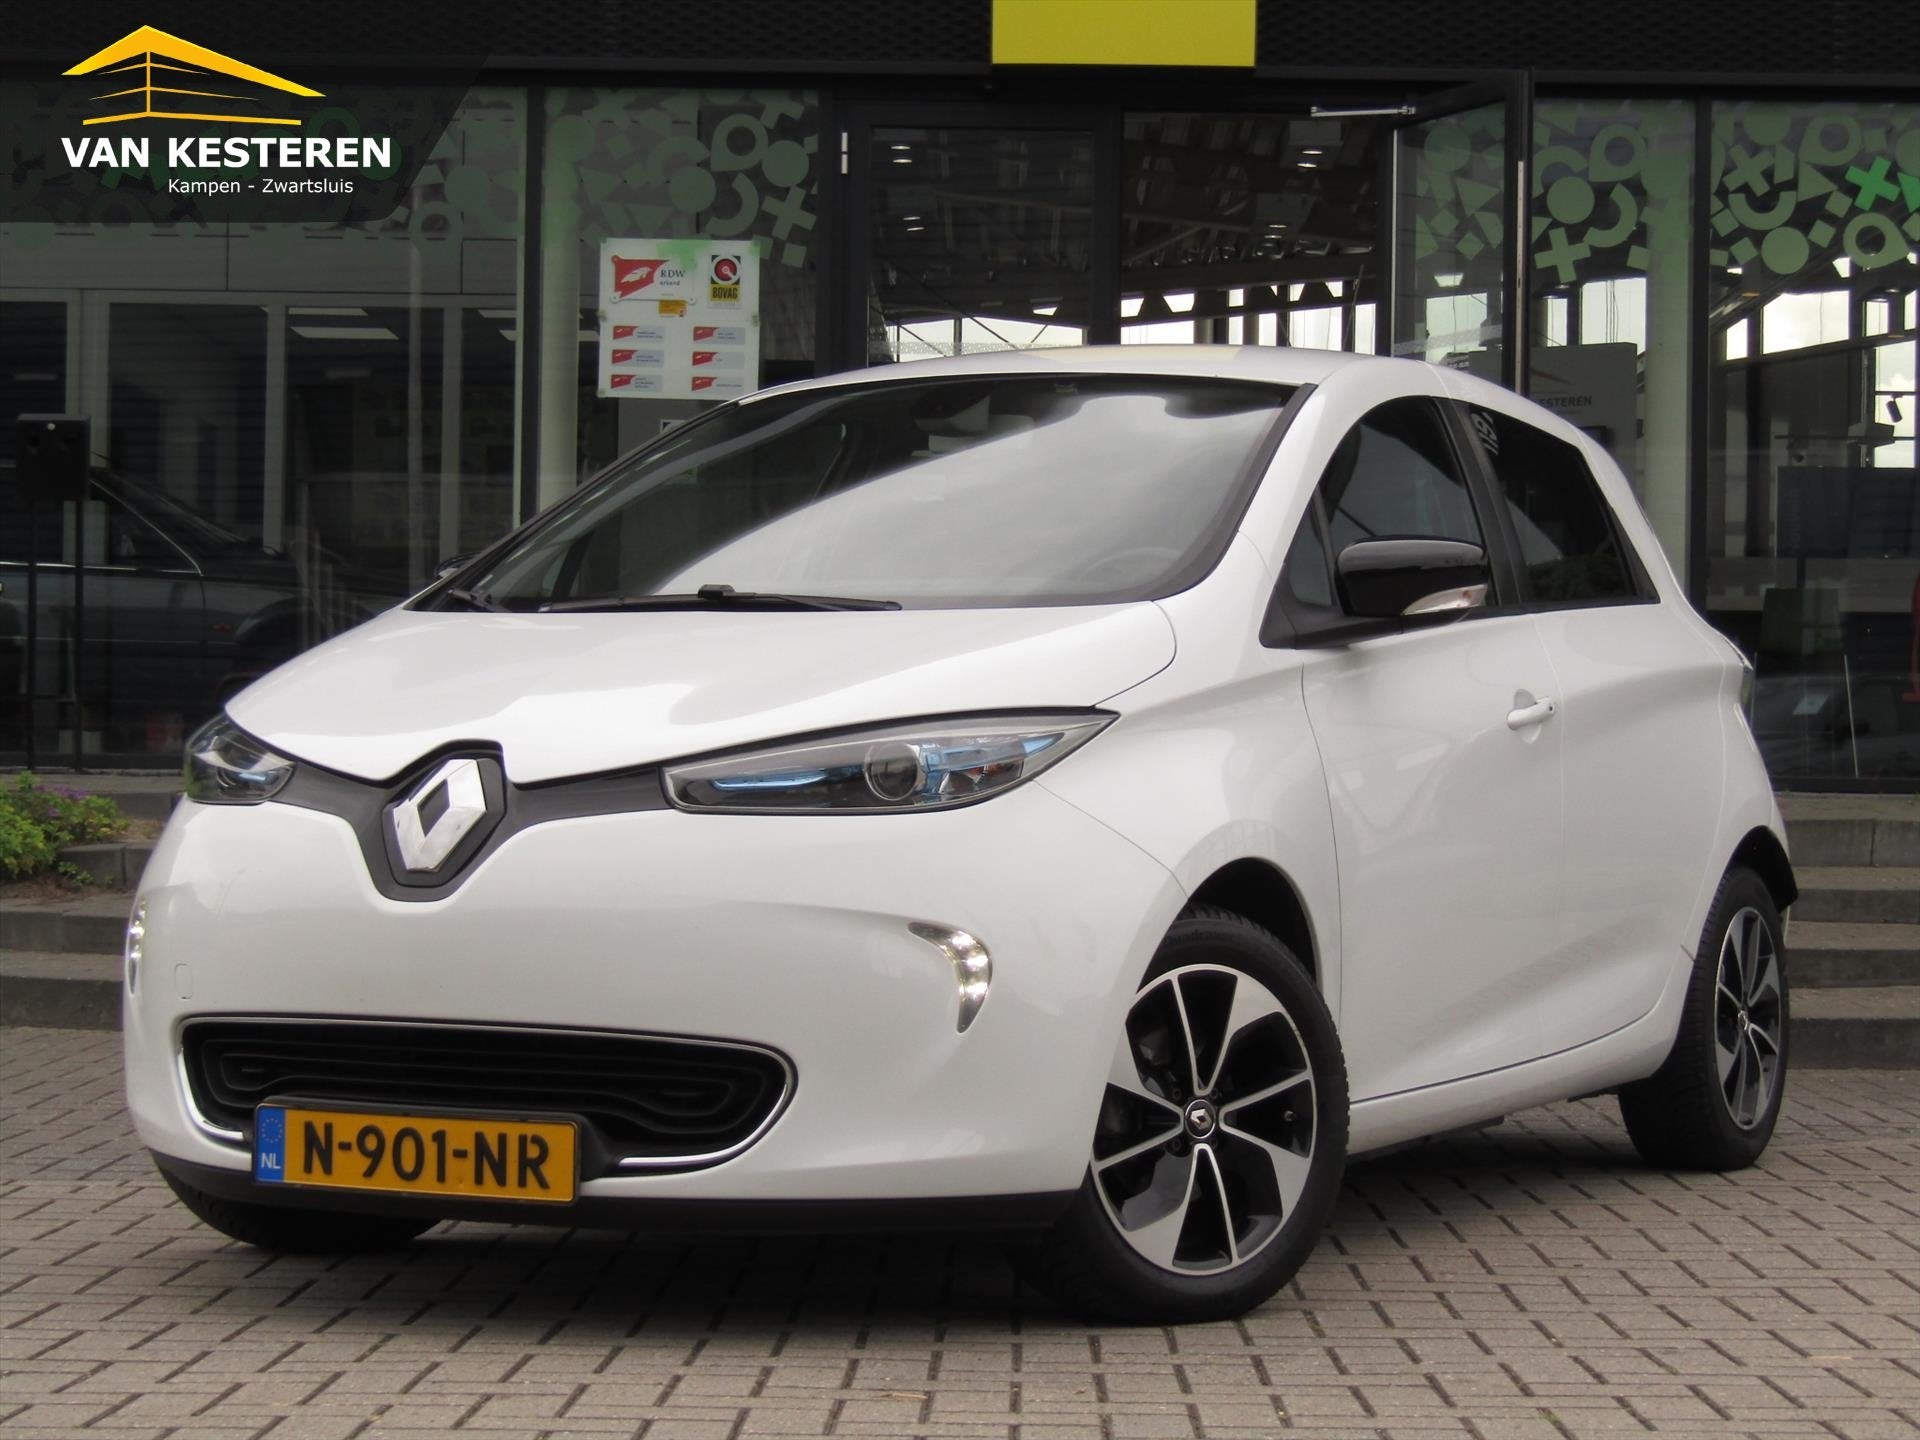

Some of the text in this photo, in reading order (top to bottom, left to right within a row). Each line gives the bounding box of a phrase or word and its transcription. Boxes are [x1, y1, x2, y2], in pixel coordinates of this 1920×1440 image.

[660, 269, 686, 278] RDW
[712, 286, 738, 299] BOVAG
[1534, 396, 1593, 408] ESTEREN
[261, 1153, 281, 1169] NL
[303, 1121, 551, 1190] N-901-NR
